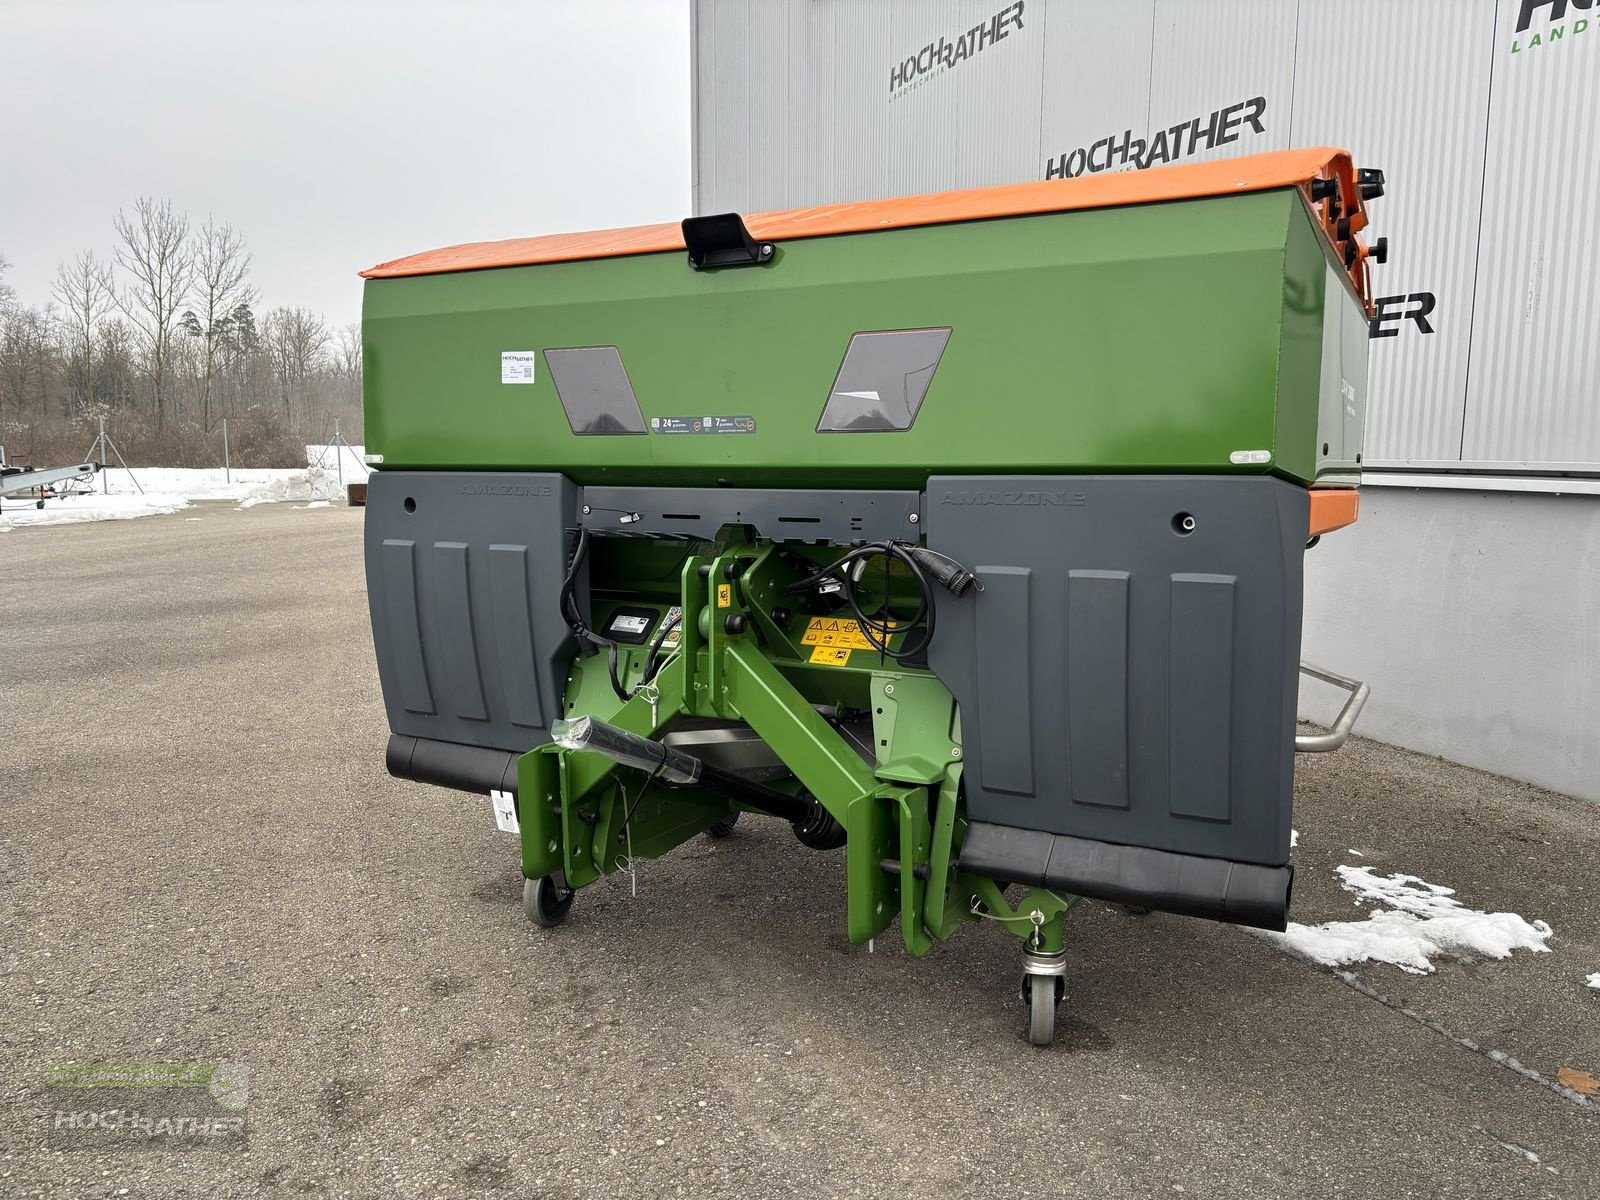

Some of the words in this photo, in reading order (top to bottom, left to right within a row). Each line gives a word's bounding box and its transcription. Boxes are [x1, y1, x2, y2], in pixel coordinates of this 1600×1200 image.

[1511, 15, 1600, 53] LAND
[889, 0, 1024, 92] HOCHRATHER
[1046, 96, 1266, 180] HOCHRATHER
[663, 418, 671, 427] 24
[716, 418, 721, 426] 7
[459, 484, 552, 496] AMAZONE
[940, 491, 1086, 506] AMAZONE
